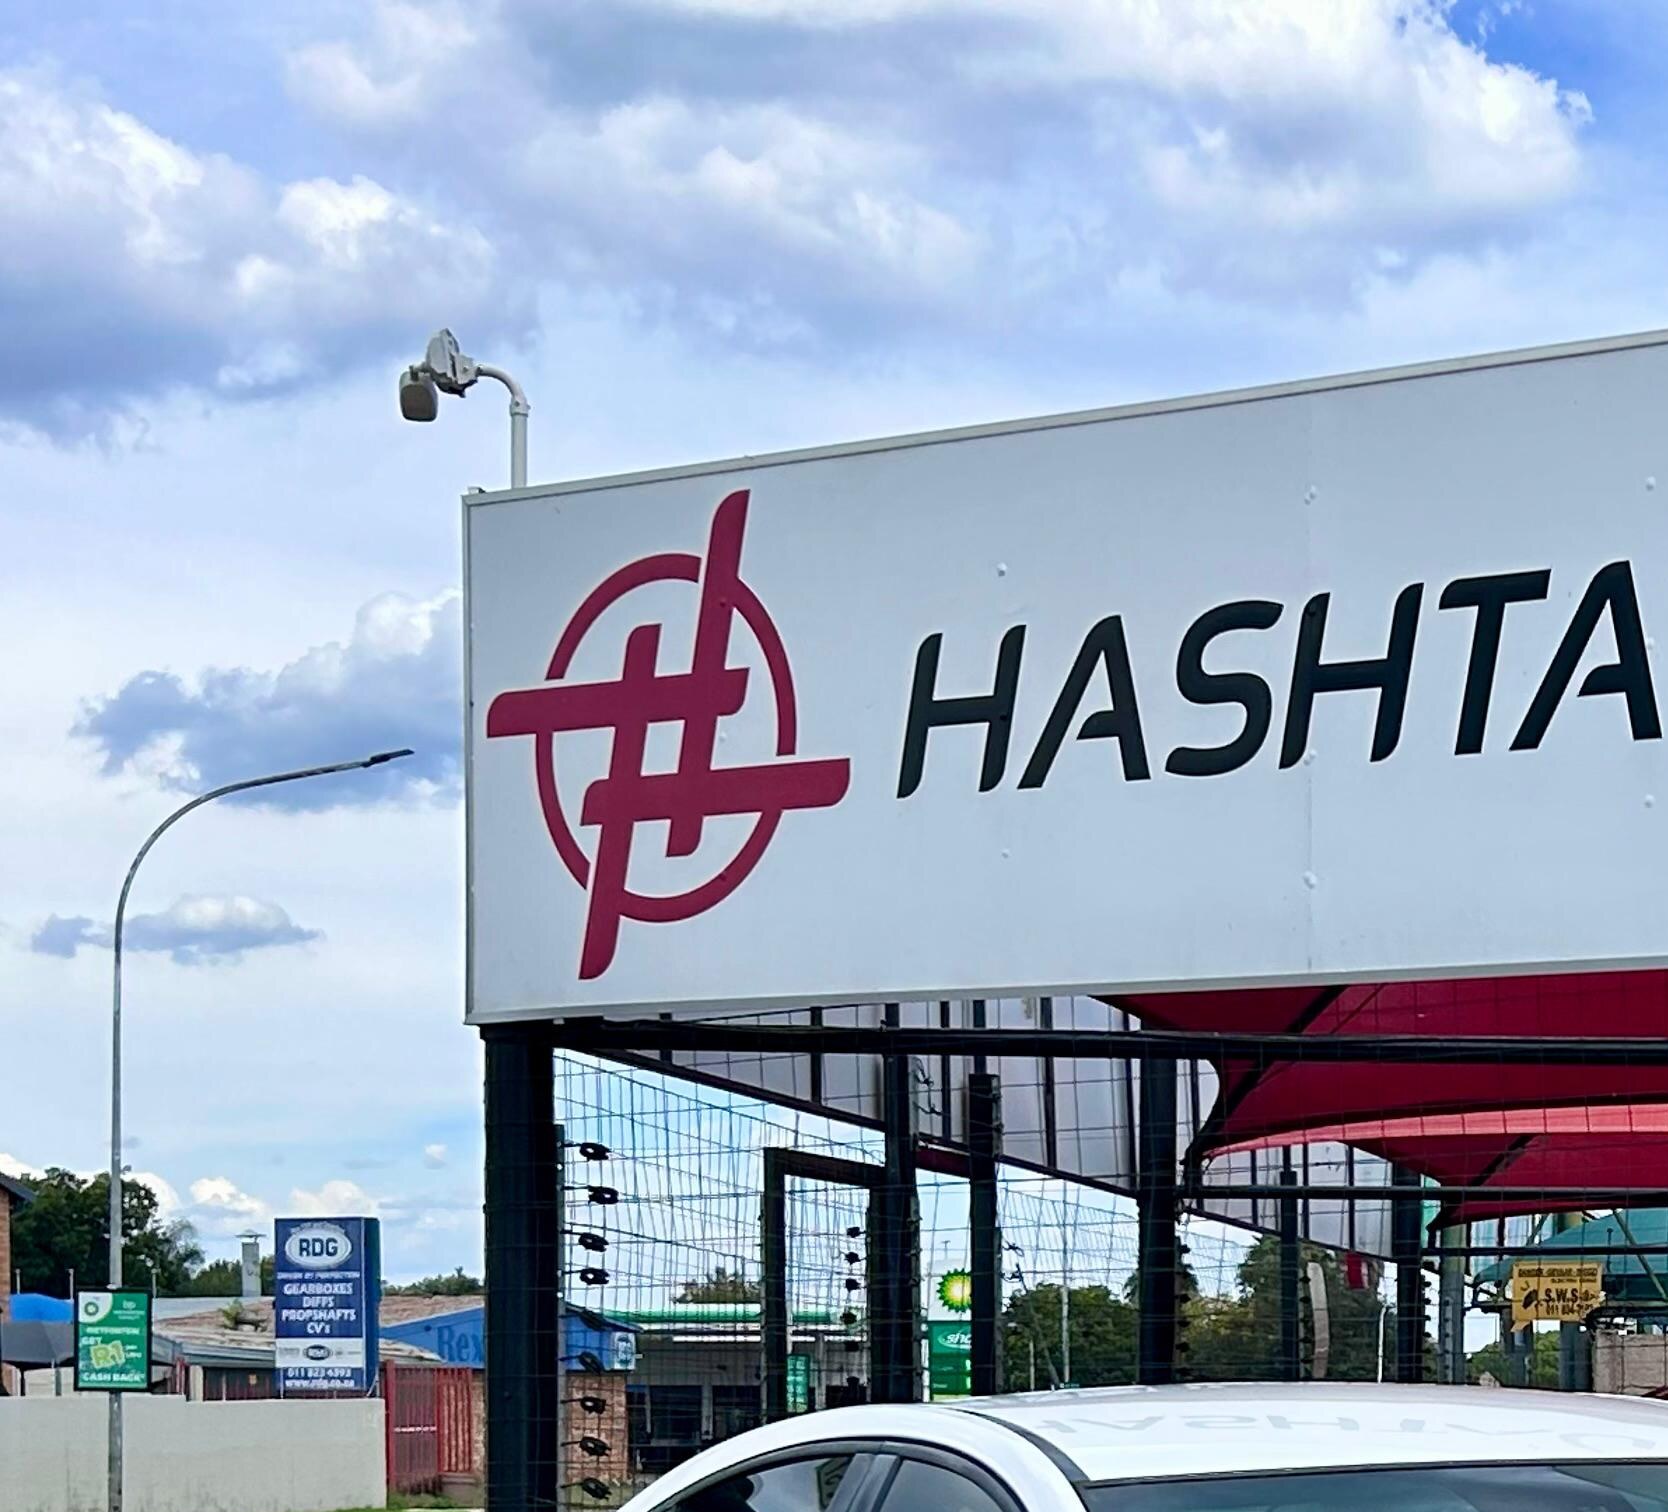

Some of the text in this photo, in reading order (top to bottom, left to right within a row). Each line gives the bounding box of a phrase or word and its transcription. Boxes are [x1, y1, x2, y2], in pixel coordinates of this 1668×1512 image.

[299, 1238, 338, 1257] RDG
[283, 1283, 353, 1295] GEARBOXES
[303, 1296, 334, 1308] DIFFS
[281, 1309, 356, 1321] PROPSHAFTS
